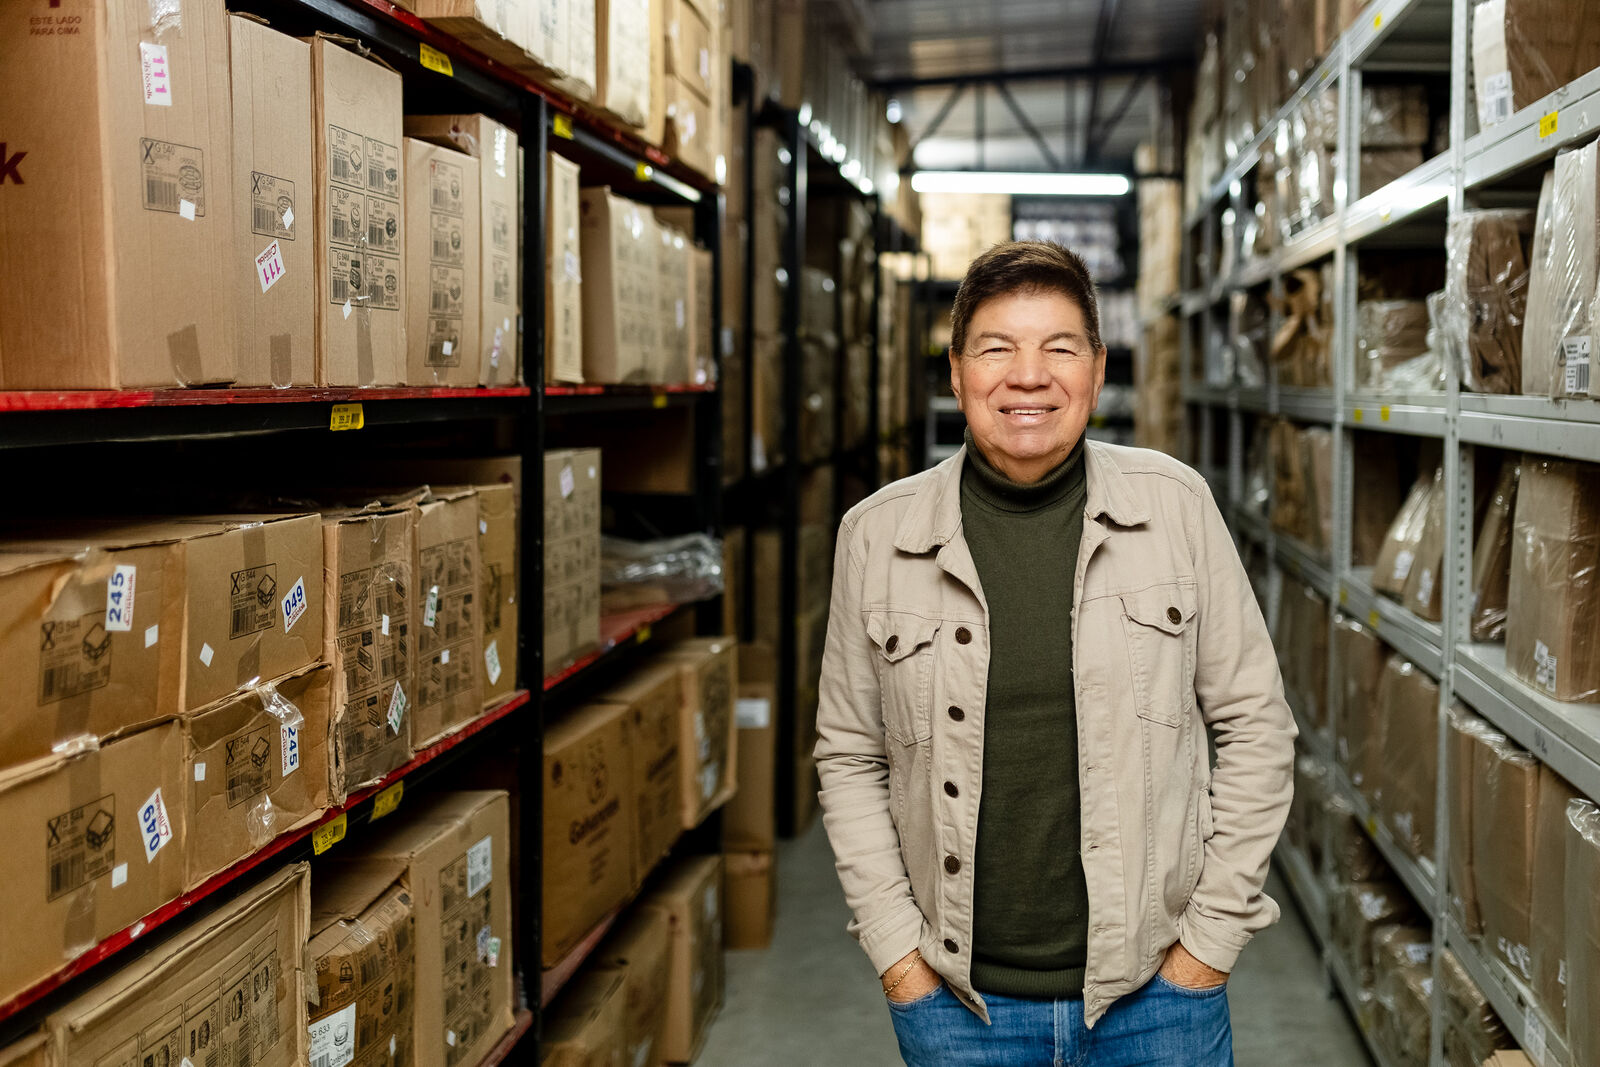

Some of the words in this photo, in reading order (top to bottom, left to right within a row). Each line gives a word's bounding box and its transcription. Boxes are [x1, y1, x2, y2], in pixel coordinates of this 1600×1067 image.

[30, 16, 53, 25] ESTE
[56, 15, 82, 25] LADO
[30, 27, 54, 36] PARA
[57, 26, 80, 35] CIMA
[152, 55, 168, 94] 111
[263, 258, 281, 285] 111
[109, 572, 125, 623] 245
[285, 585, 303, 617] 049
[287, 726, 298, 767] 245
[143, 804, 160, 852] 049
[311, 1030, 317, 1039] G
[318, 1023, 331, 1036] 633
